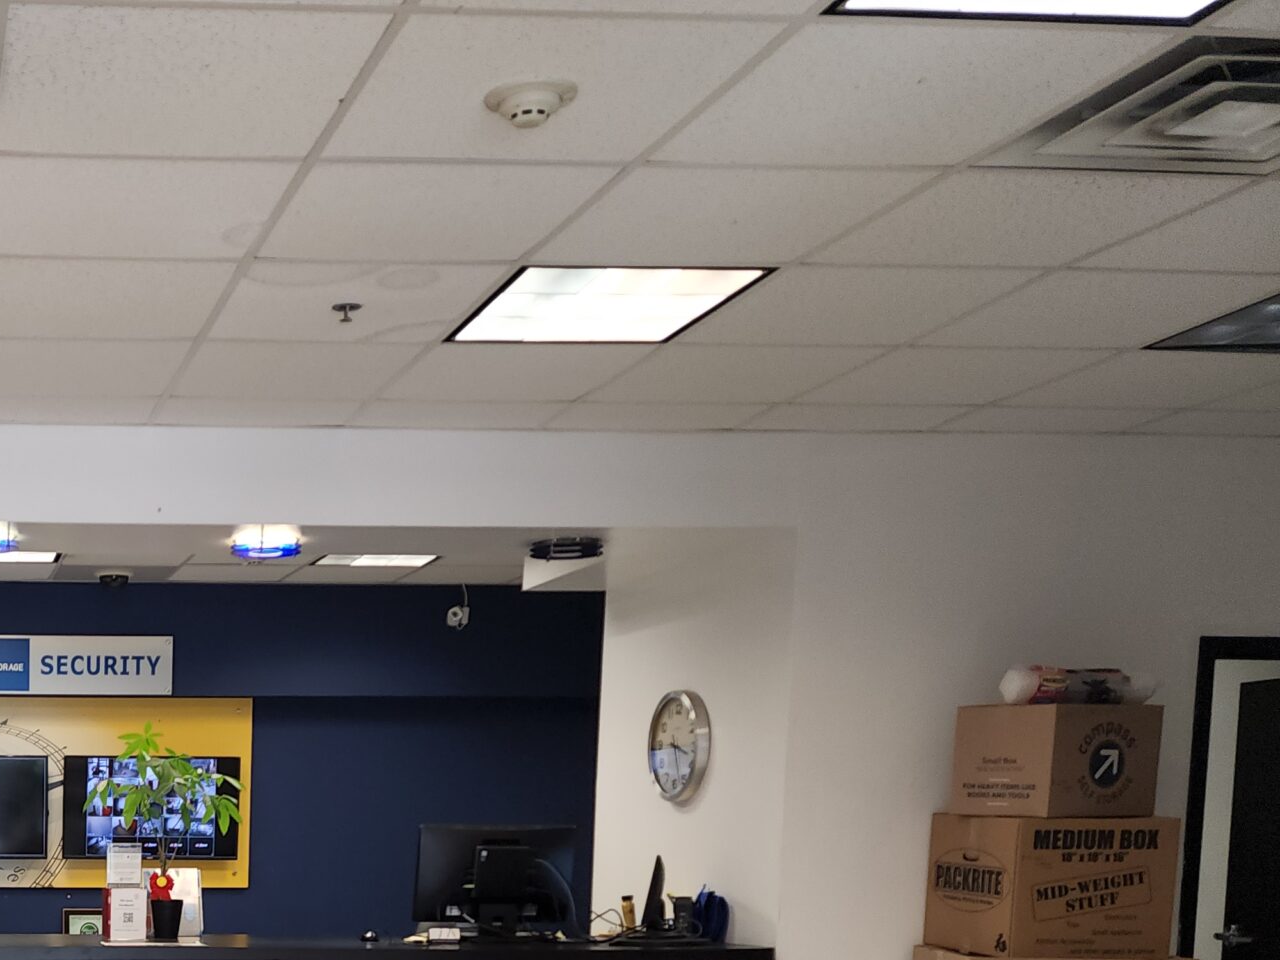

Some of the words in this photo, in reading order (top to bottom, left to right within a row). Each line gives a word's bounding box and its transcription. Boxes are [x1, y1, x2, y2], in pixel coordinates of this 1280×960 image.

[40, 655, 161, 676] SECURITY
[1078, 721, 1136, 754] compass
[1033, 829, 1116, 851] MEDIUM
[1119, 829, 1160, 851] BOX
[935, 863, 1003, 896] PACKRITE
[1036, 871, 1146, 903] MID-WEIGHT
[1065, 891, 1120, 914] STUFF
